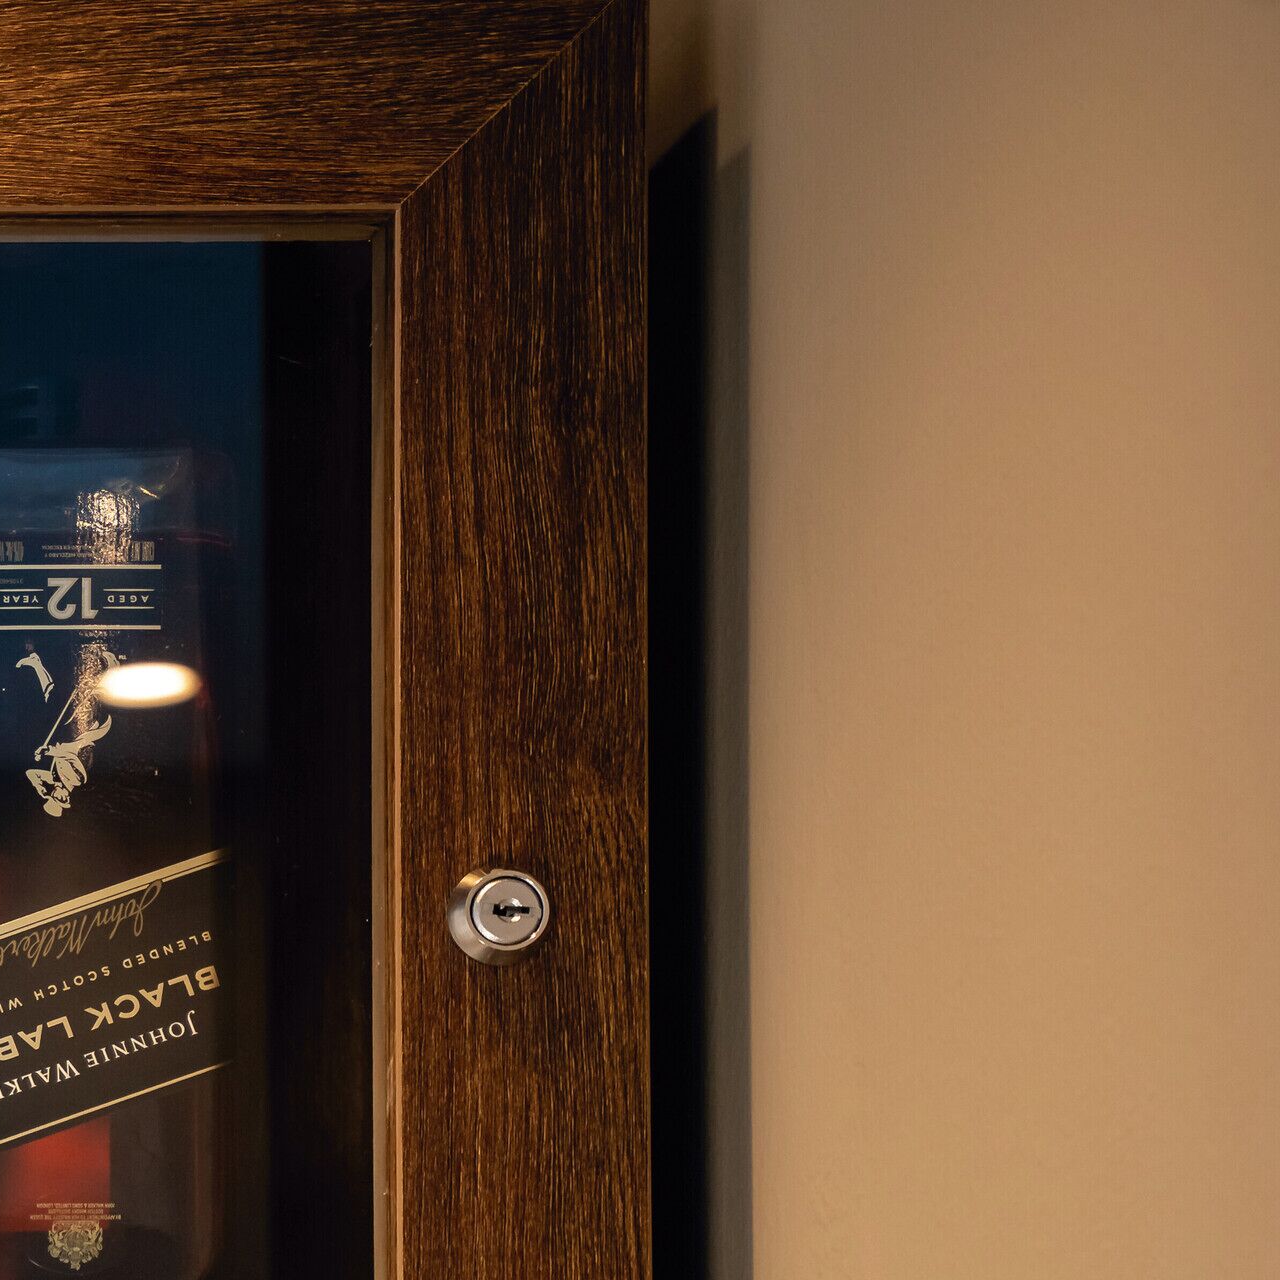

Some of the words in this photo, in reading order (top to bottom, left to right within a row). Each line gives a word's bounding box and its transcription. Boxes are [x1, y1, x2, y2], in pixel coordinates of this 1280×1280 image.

[46, 577, 99, 620] 12
[107, 595, 149, 604] AGED
[121, 930, 211, 969] BLENDED
[32, 964, 111, 1001] SCOTCH
[83, 965, 221, 1031] BLACK
[83, 1010, 199, 1068] JOHNNIE
